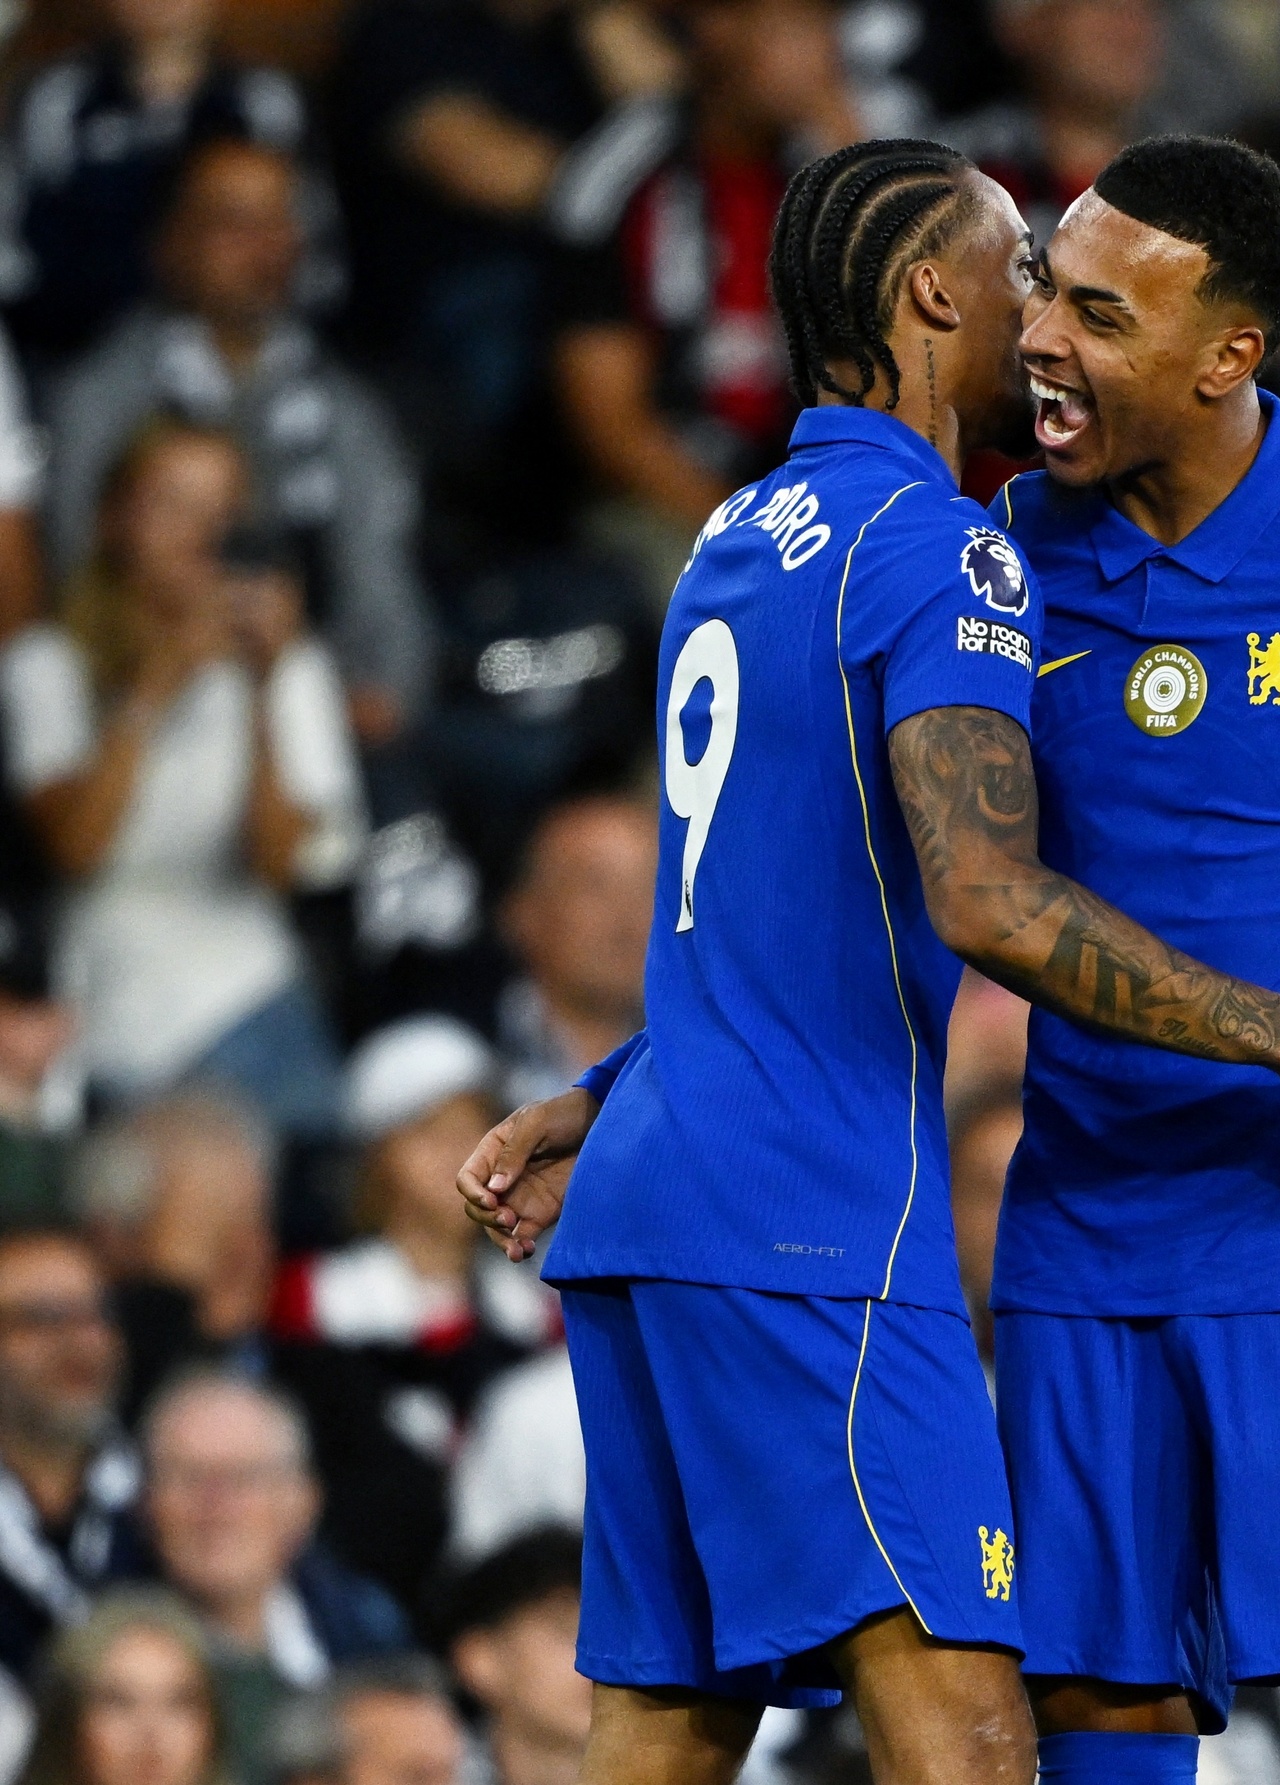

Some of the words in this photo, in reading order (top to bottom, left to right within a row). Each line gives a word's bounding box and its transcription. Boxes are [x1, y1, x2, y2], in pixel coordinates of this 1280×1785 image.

[957, 617, 988, 637] No
[991, 624, 1030, 654] room
[958, 633, 987, 651] for
[990, 639, 1032, 673] racism
[1130, 659, 1153, 701] WORLD
[1154, 651, 1199, 700] CHAMPIONS
[1146, 715, 1177, 728] FIFA
[665, 617, 739, 933] 9
[772, 1242, 847, 1258] AERO-FIT
